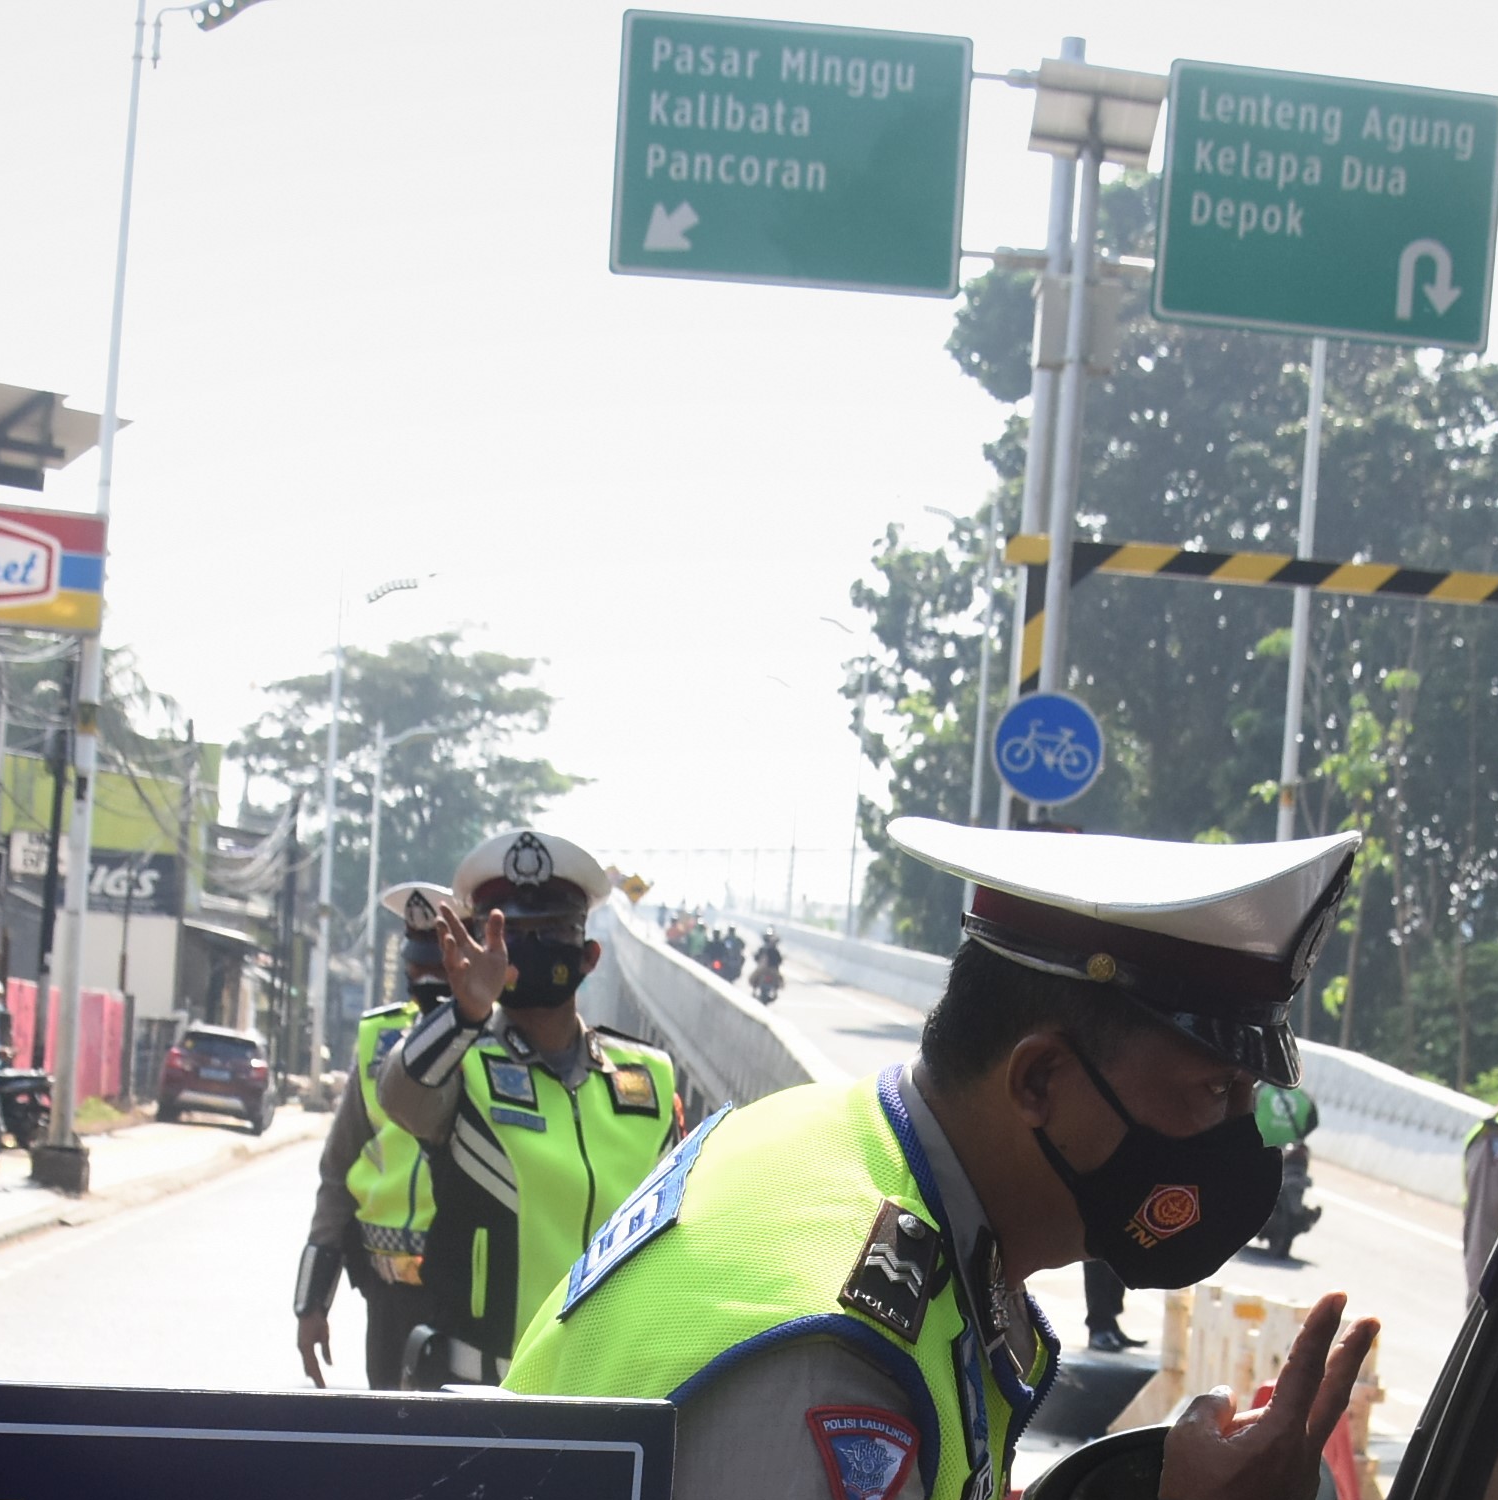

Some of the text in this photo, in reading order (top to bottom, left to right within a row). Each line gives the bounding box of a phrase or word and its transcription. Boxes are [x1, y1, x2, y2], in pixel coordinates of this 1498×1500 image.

[652, 37, 916, 99] Pasar Minggu
[649, 90, 811, 137] Kalibata
[1198, 86, 1475, 161] Lenteng Agung
[646, 144, 827, 192] Pancoran
[1194, 138, 1407, 196] Kelapa Dua
[1191, 191, 1304, 239] Depok
[1124, 1219, 1158, 1249] TNI
[852, 1288, 910, 1329] POLISI
[822, 1418, 913, 1446] POLISI LALU LINTAS
